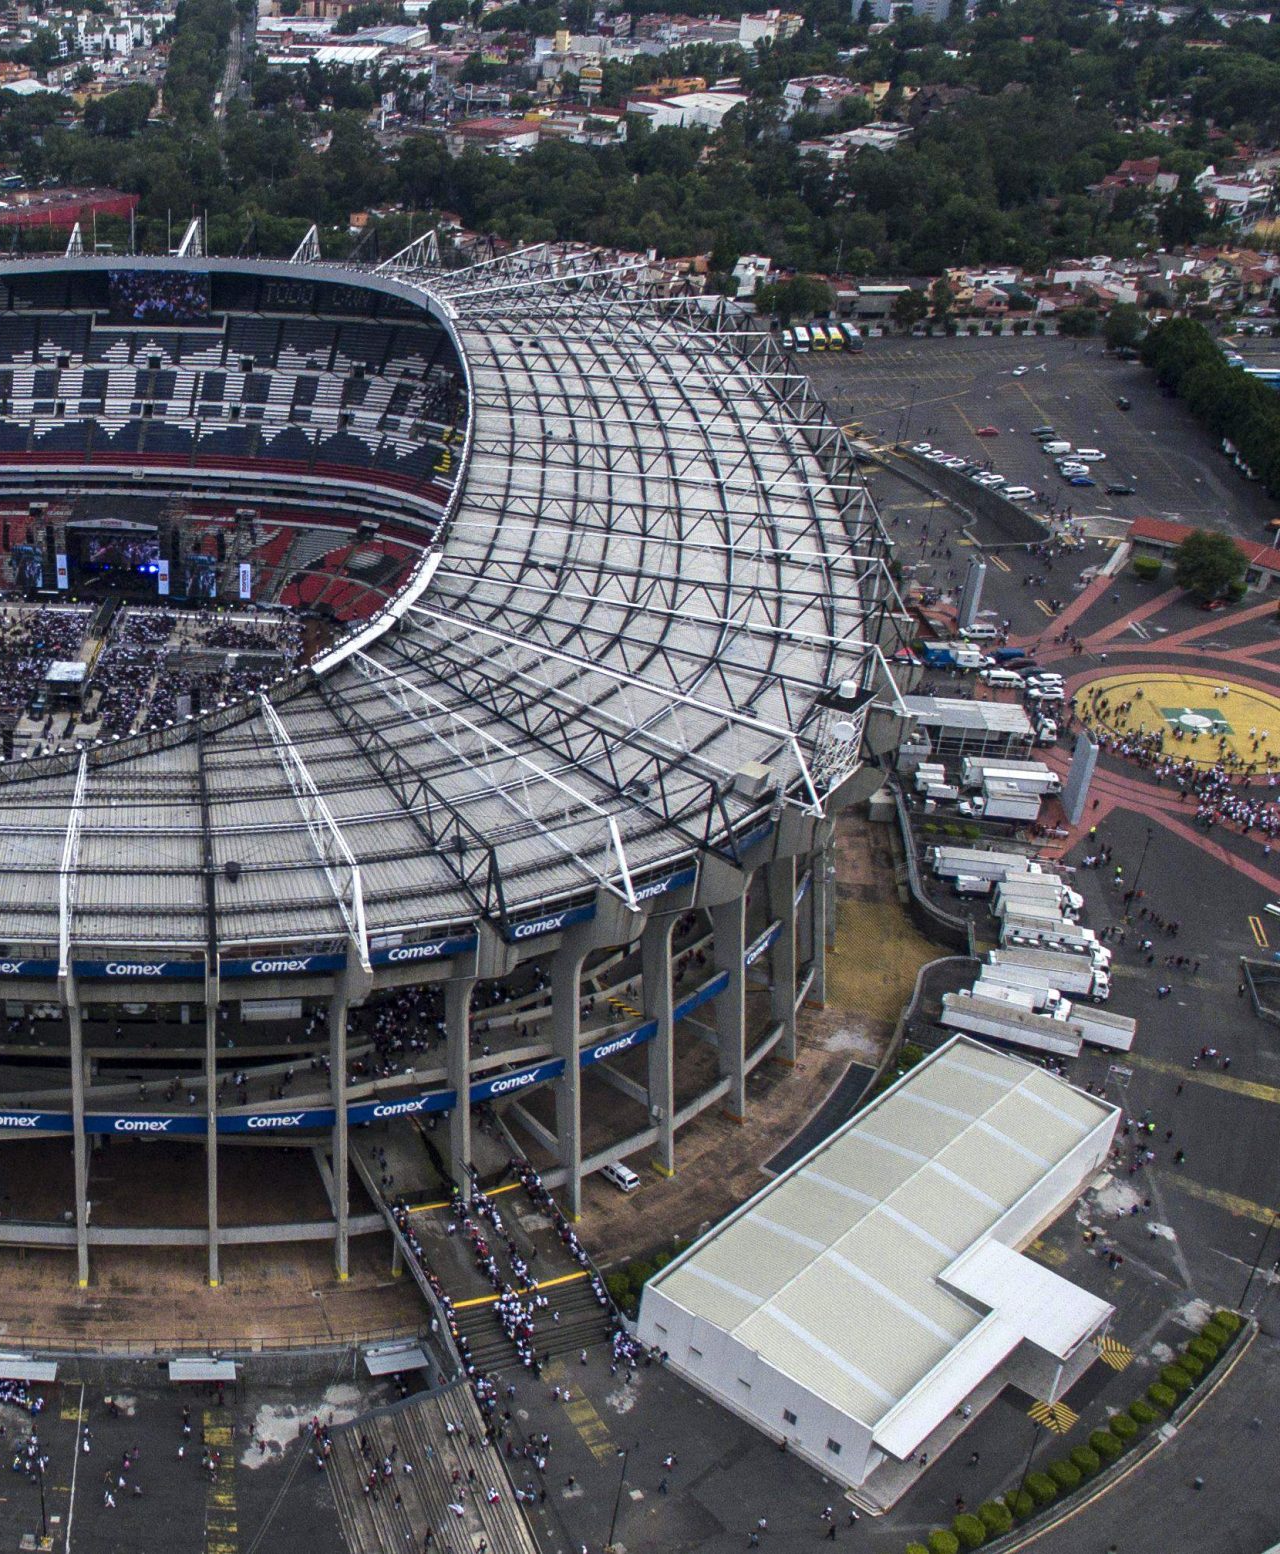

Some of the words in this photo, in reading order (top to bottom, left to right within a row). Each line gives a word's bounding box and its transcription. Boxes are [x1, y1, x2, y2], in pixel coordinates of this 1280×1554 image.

[633, 876, 672, 902] omex
[514, 913, 566, 938] Comex
[388, 941, 446, 961] Comex
[105, 963, 166, 976] Comex
[251, 957, 311, 973] Comex
[593, 1032, 636, 1059] Comex
[490, 1069, 539, 1093] Comex
[373, 1097, 428, 1117] Comex
[114, 1116, 172, 1131] Comex
[247, 1113, 305, 1128] Comex
